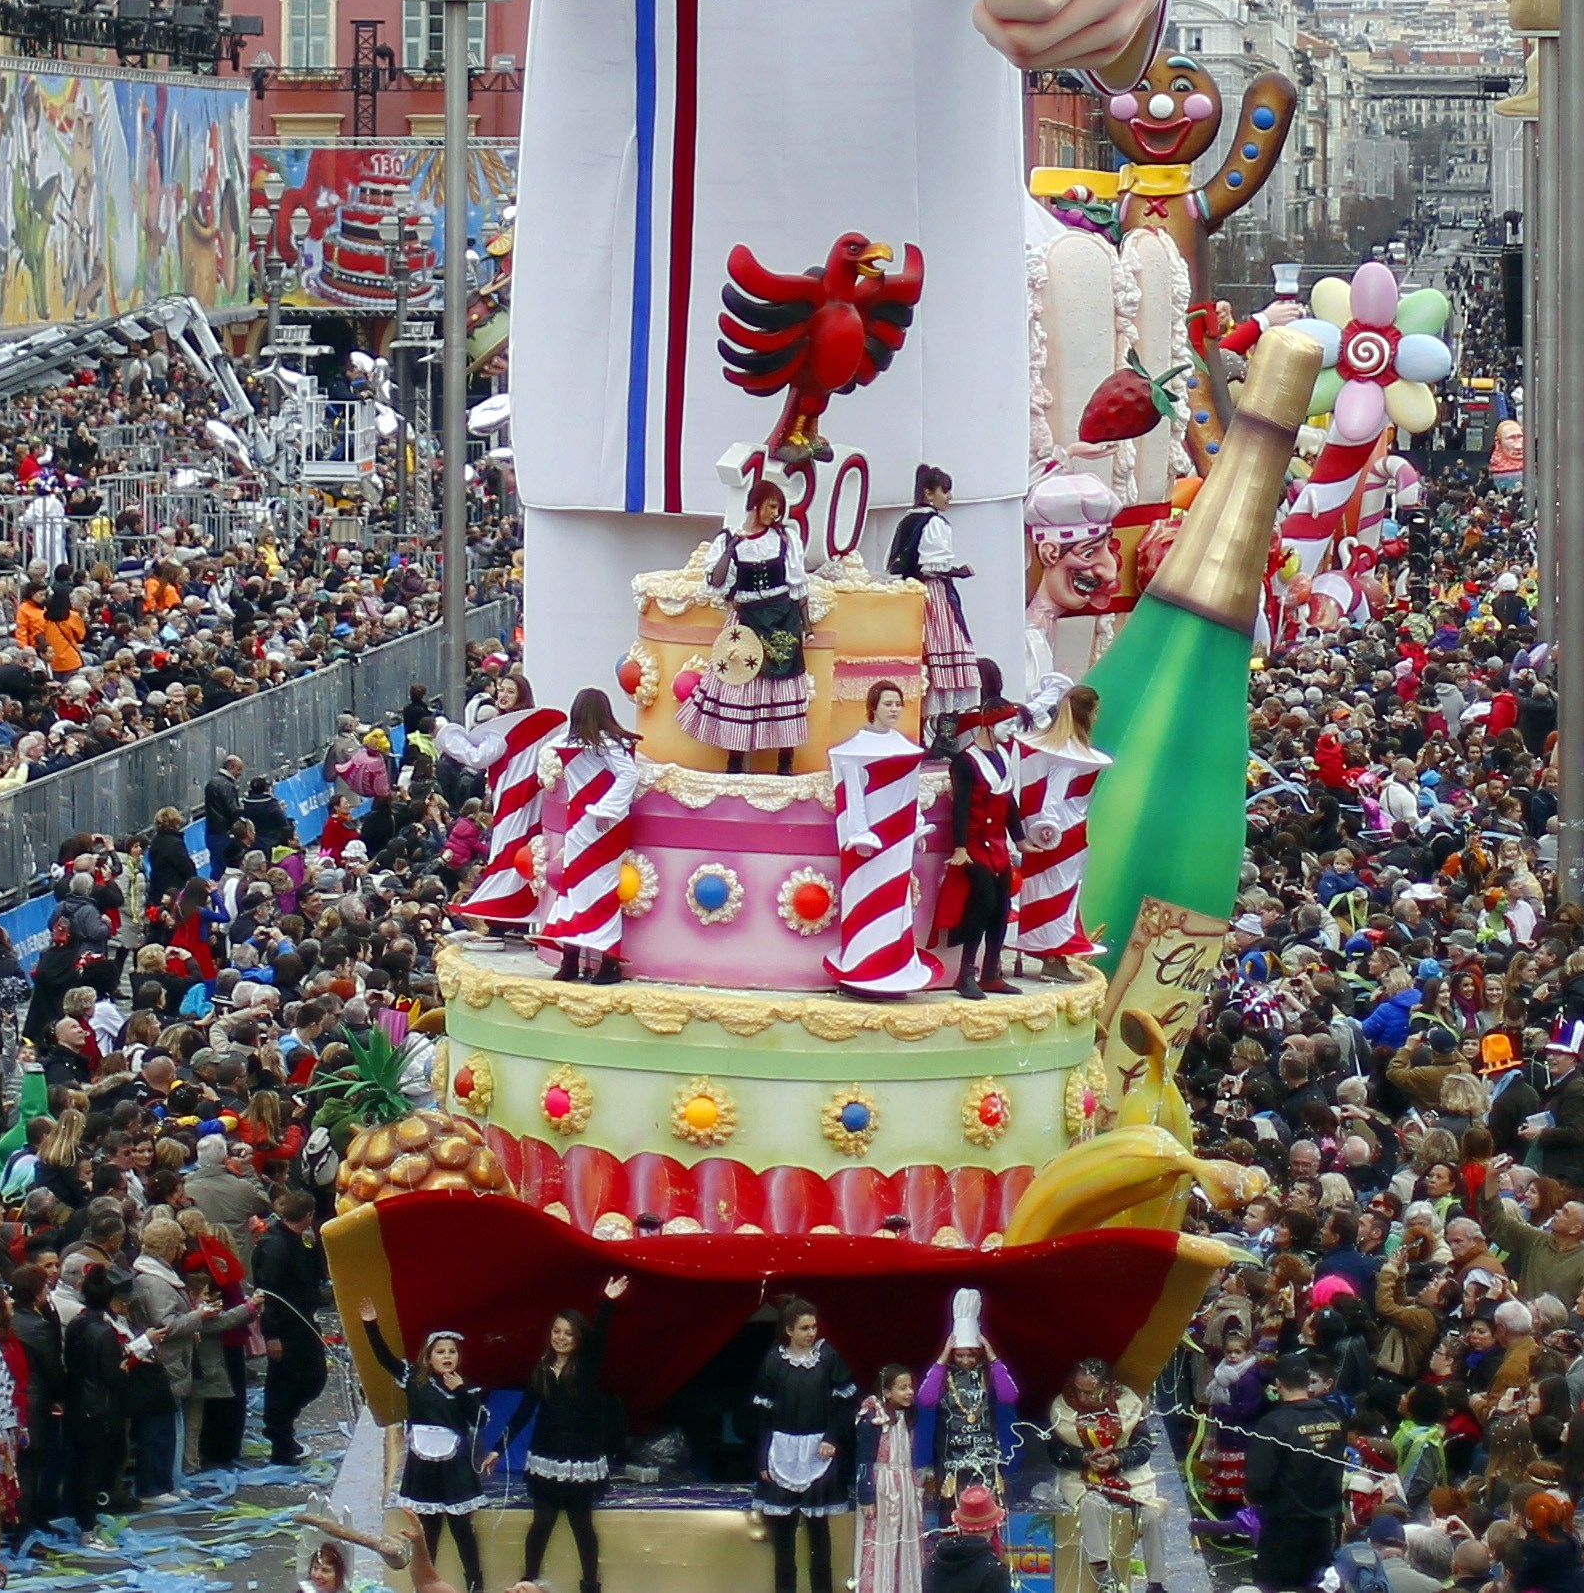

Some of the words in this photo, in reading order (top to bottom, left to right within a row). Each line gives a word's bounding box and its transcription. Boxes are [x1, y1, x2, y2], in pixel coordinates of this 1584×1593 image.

[371, 153, 404, 176] 130
[961, 1423, 981, 1434] ceci
[973, 1436, 993, 1448] pas
